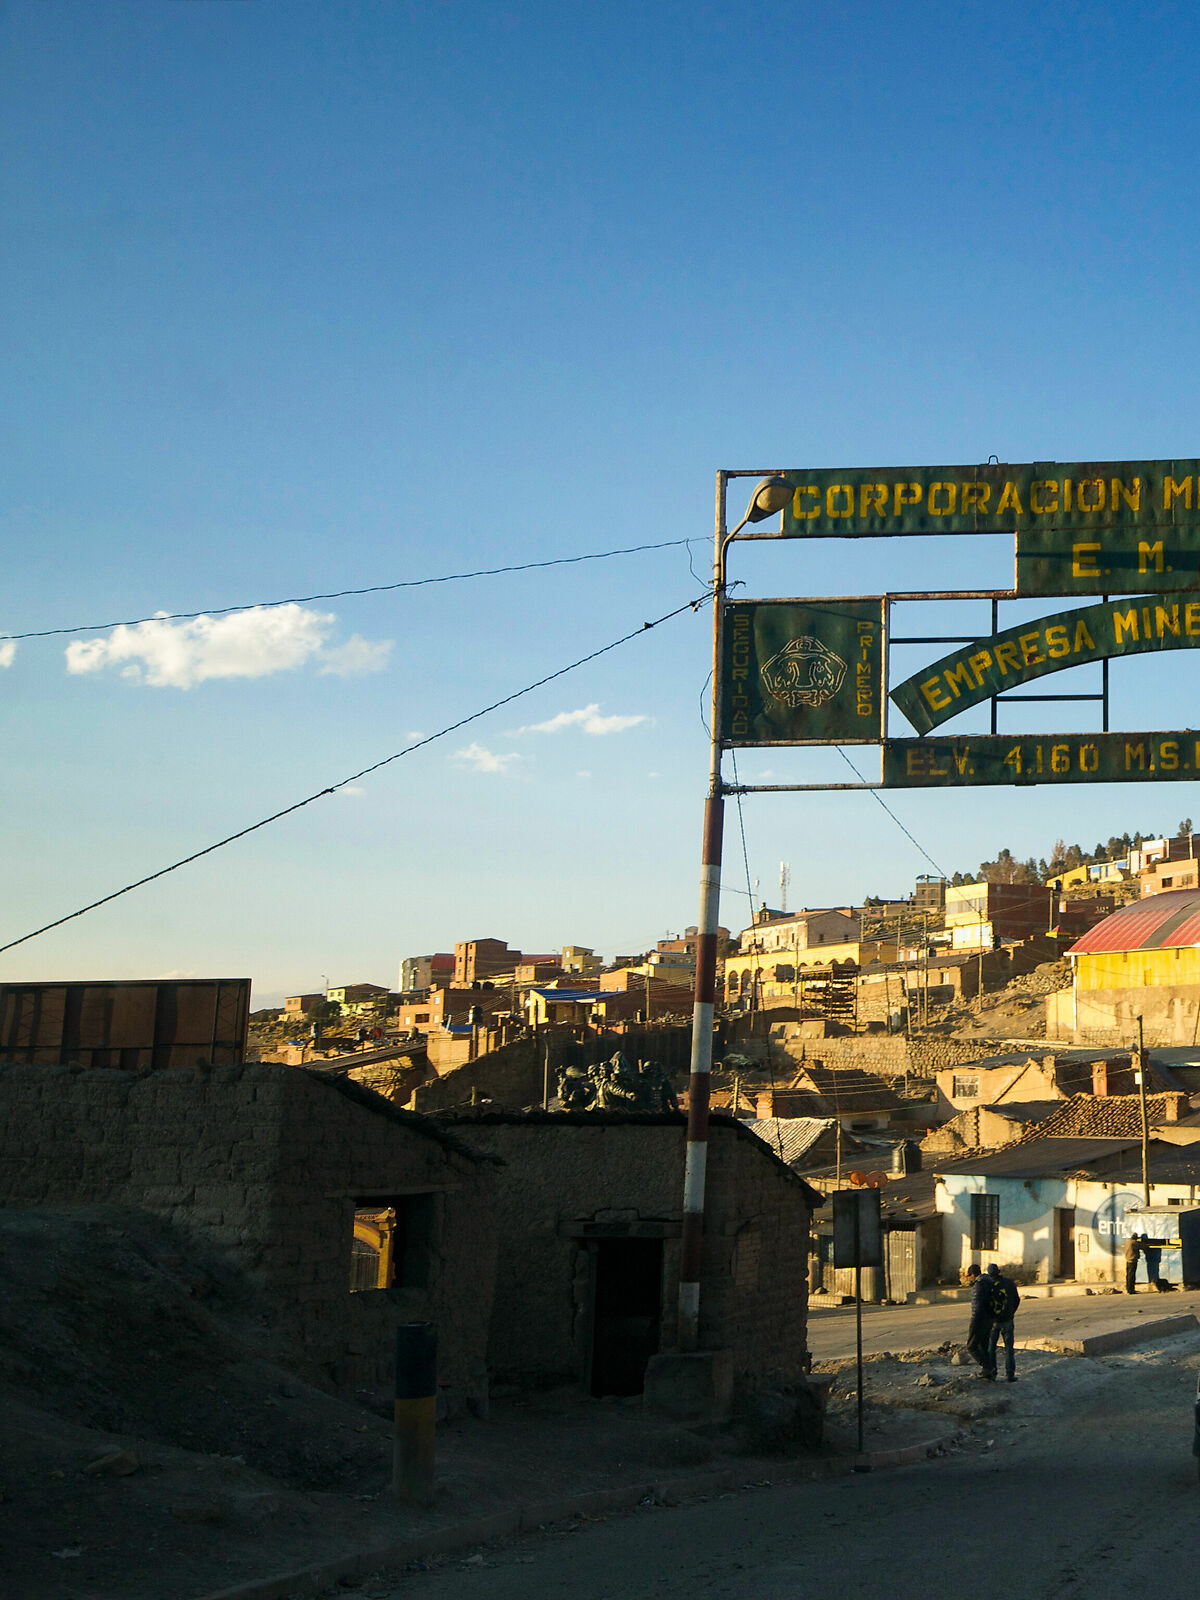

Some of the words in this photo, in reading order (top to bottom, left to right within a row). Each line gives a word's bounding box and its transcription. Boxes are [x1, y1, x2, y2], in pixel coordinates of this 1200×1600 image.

[792, 478, 1140, 520] CORPORACION
[732, 614, 750, 735] SEGURIDAD
[856, 621, 874, 716] PRIMERO
[919, 619, 1096, 712] EMPRESA
